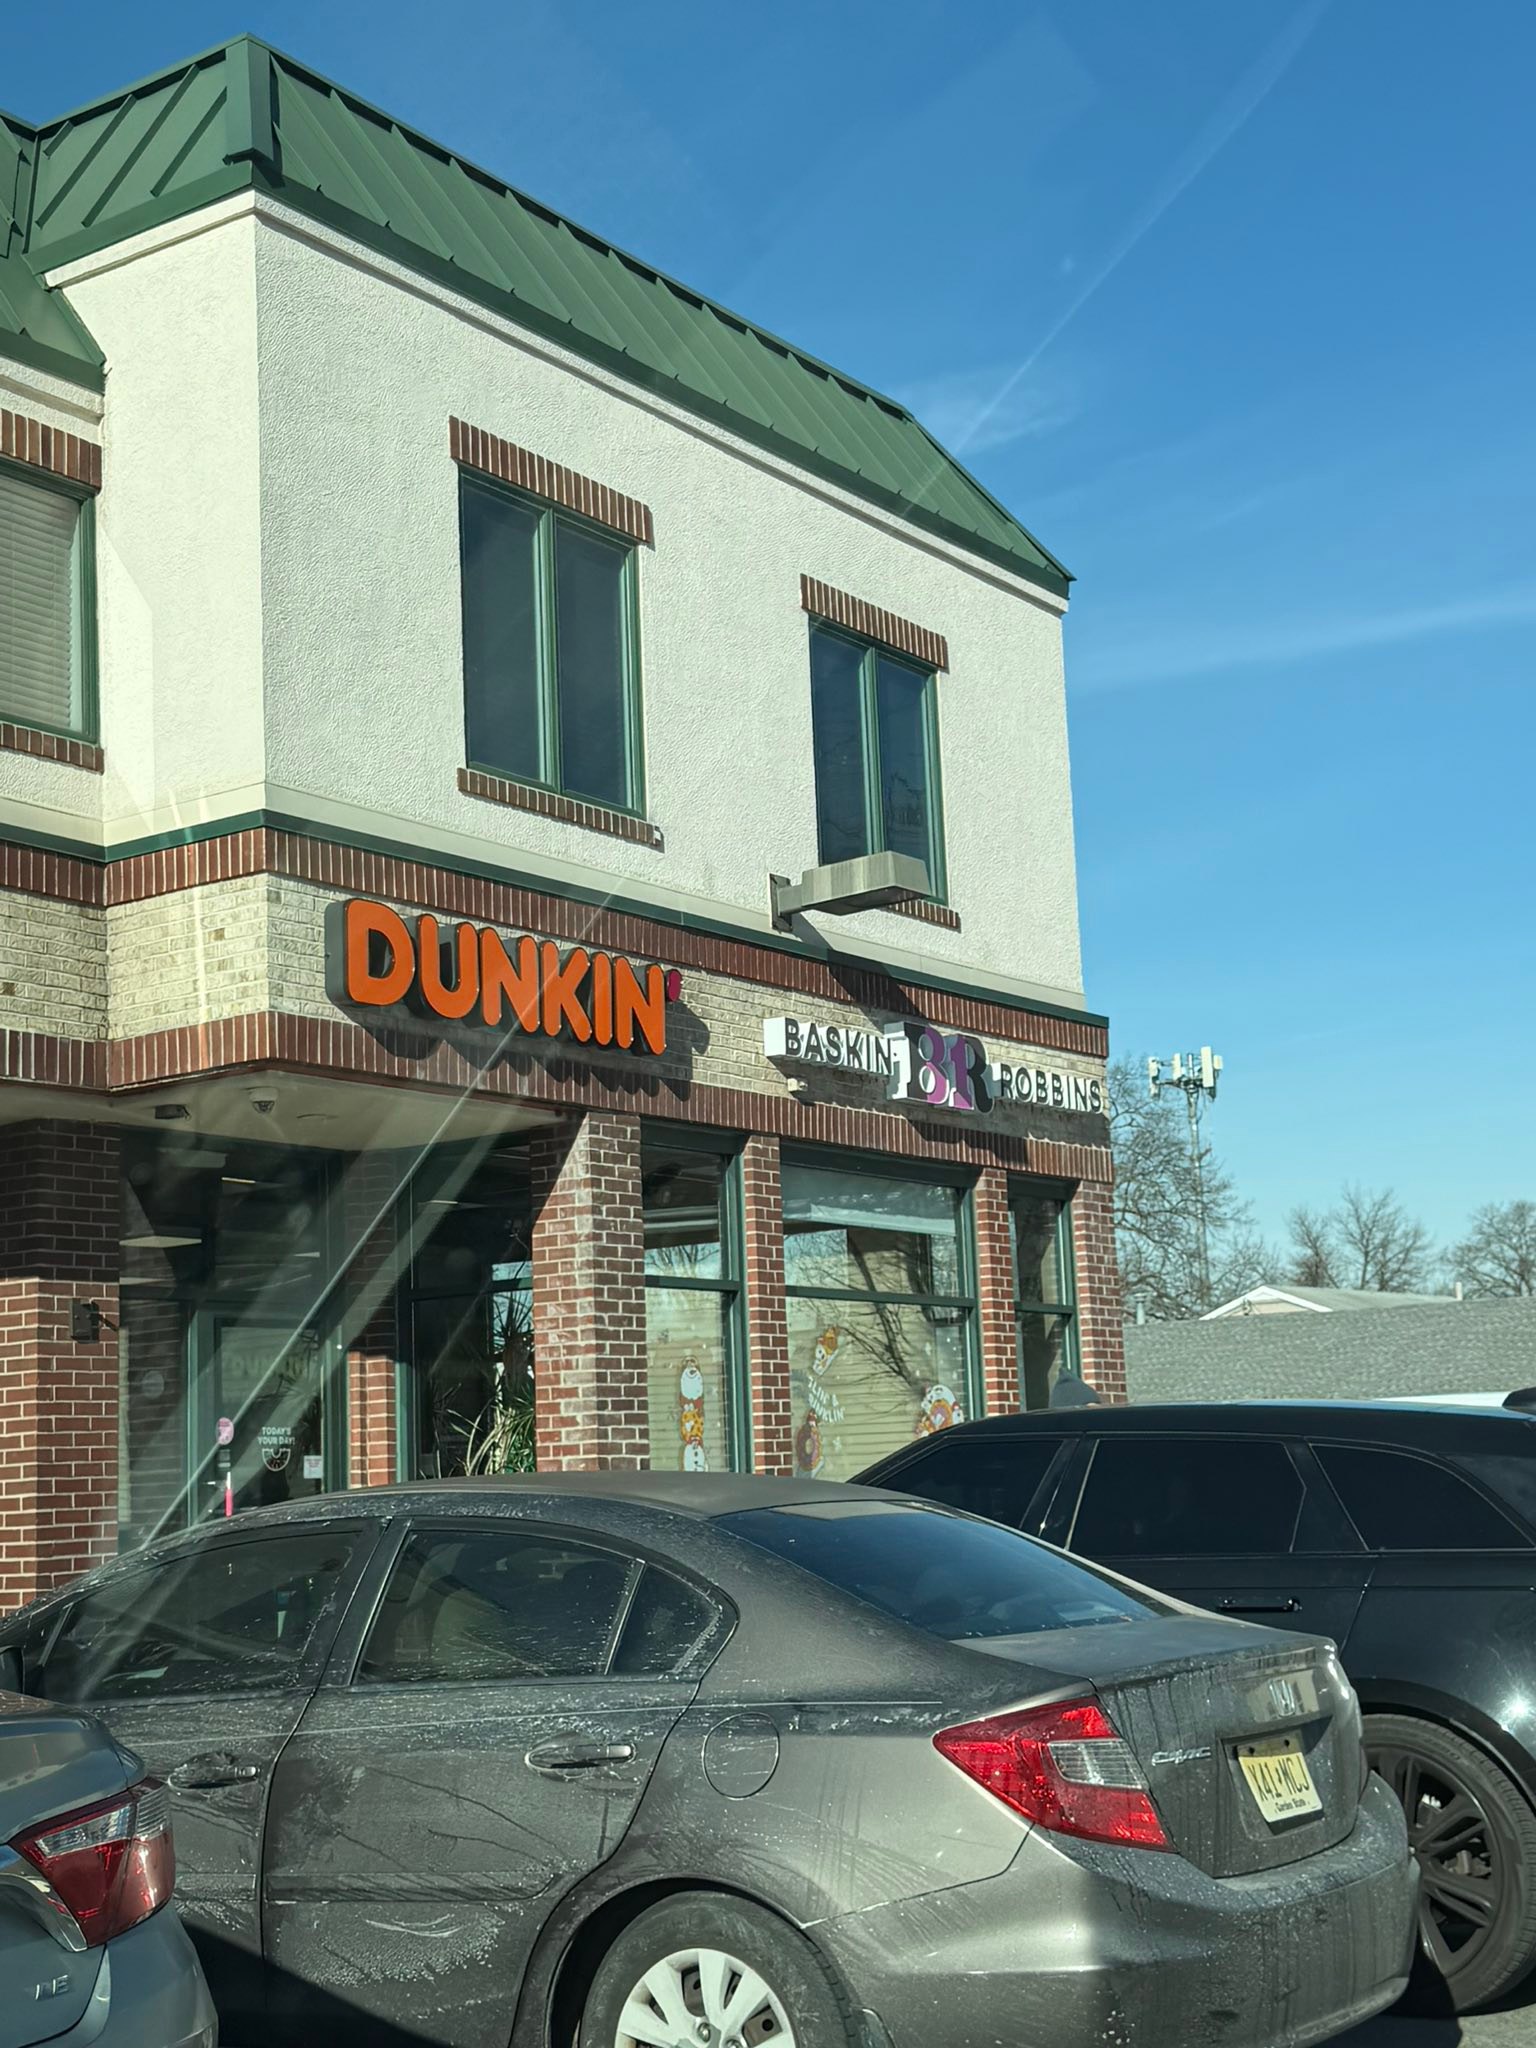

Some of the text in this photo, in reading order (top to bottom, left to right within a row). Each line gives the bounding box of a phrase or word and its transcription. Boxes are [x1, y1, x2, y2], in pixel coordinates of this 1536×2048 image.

[343, 897, 684, 1056] DUNKIN'
[784, 1017, 893, 1075] BASKIN
[1000, 1063, 1103, 1114] ROBBINS
